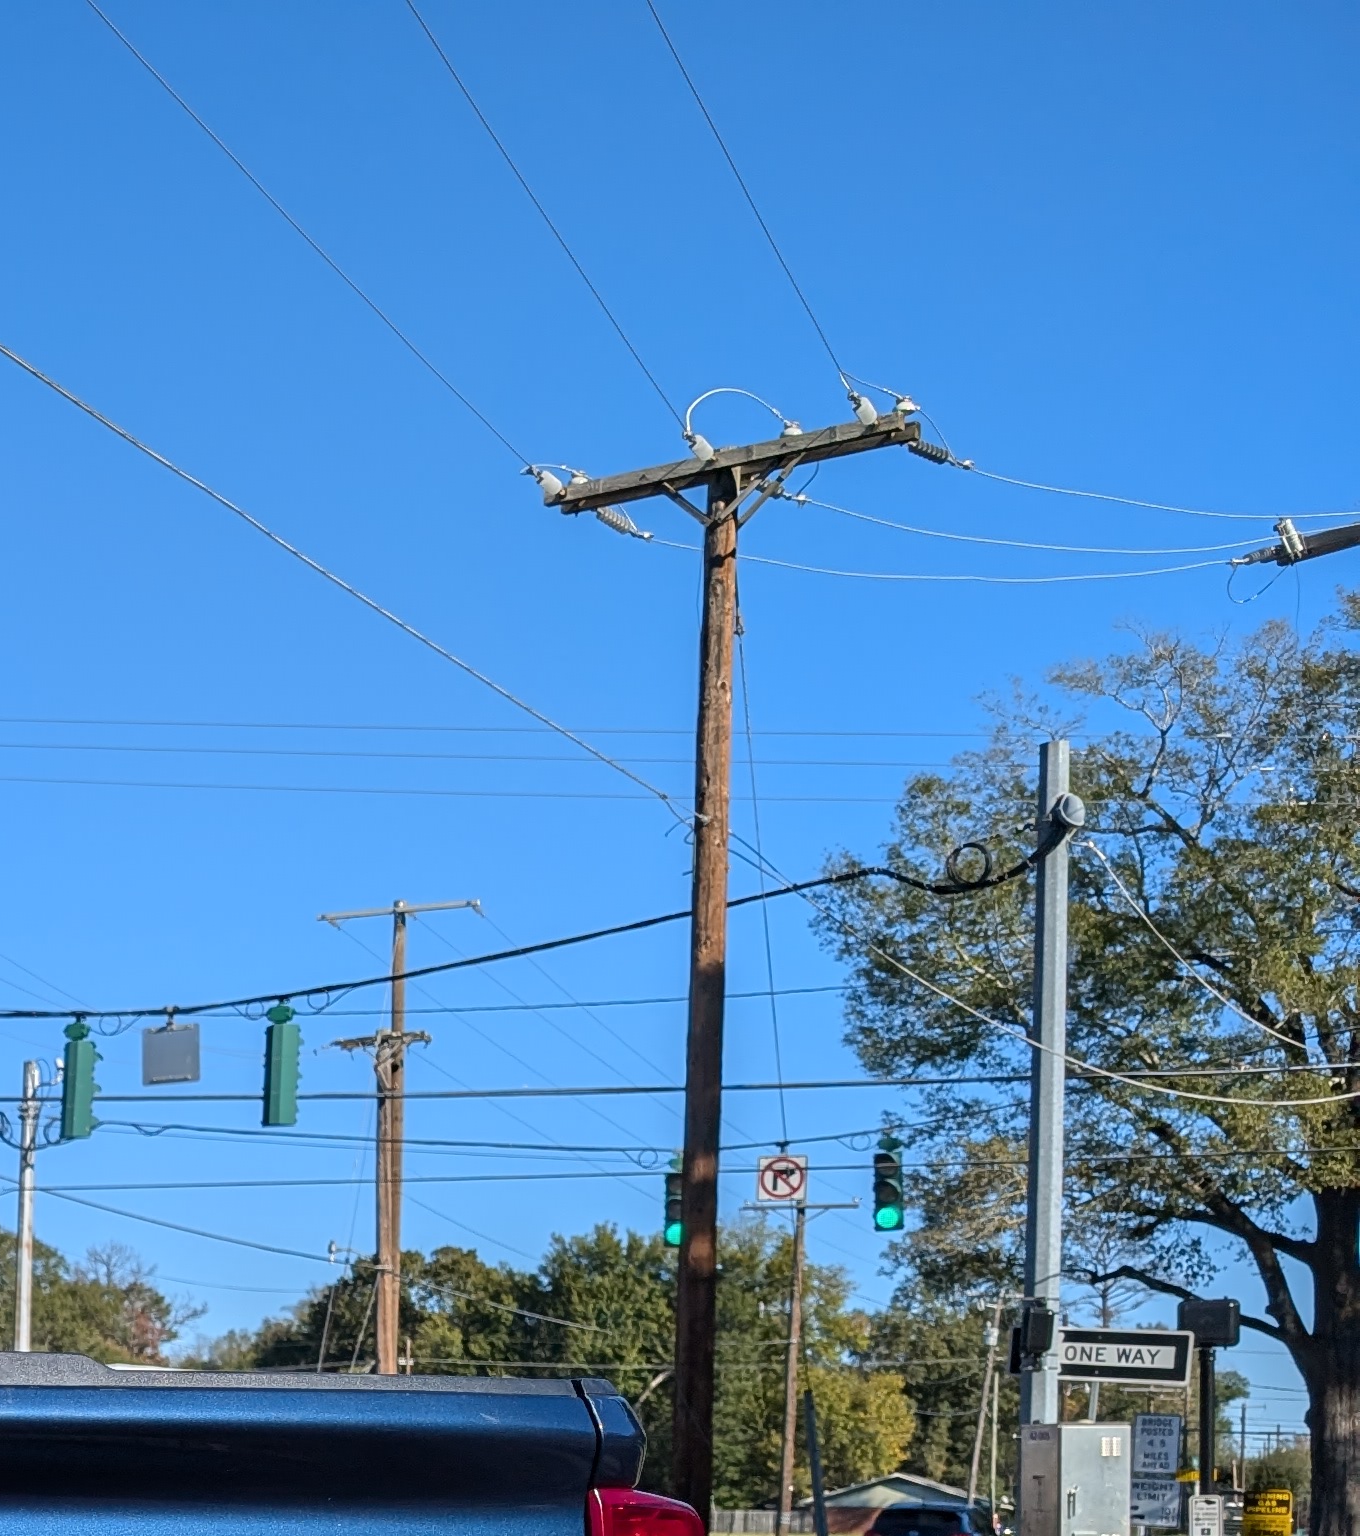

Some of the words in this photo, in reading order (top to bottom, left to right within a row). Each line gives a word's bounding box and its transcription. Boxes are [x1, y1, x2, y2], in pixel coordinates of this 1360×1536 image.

[1064, 1345, 1107, 1363] ONE
[1117, 1347, 1161, 1365] WAY
[1131, 1482, 1175, 1491] WEIGHT
[1136, 1492, 1167, 1502] LIMIT
